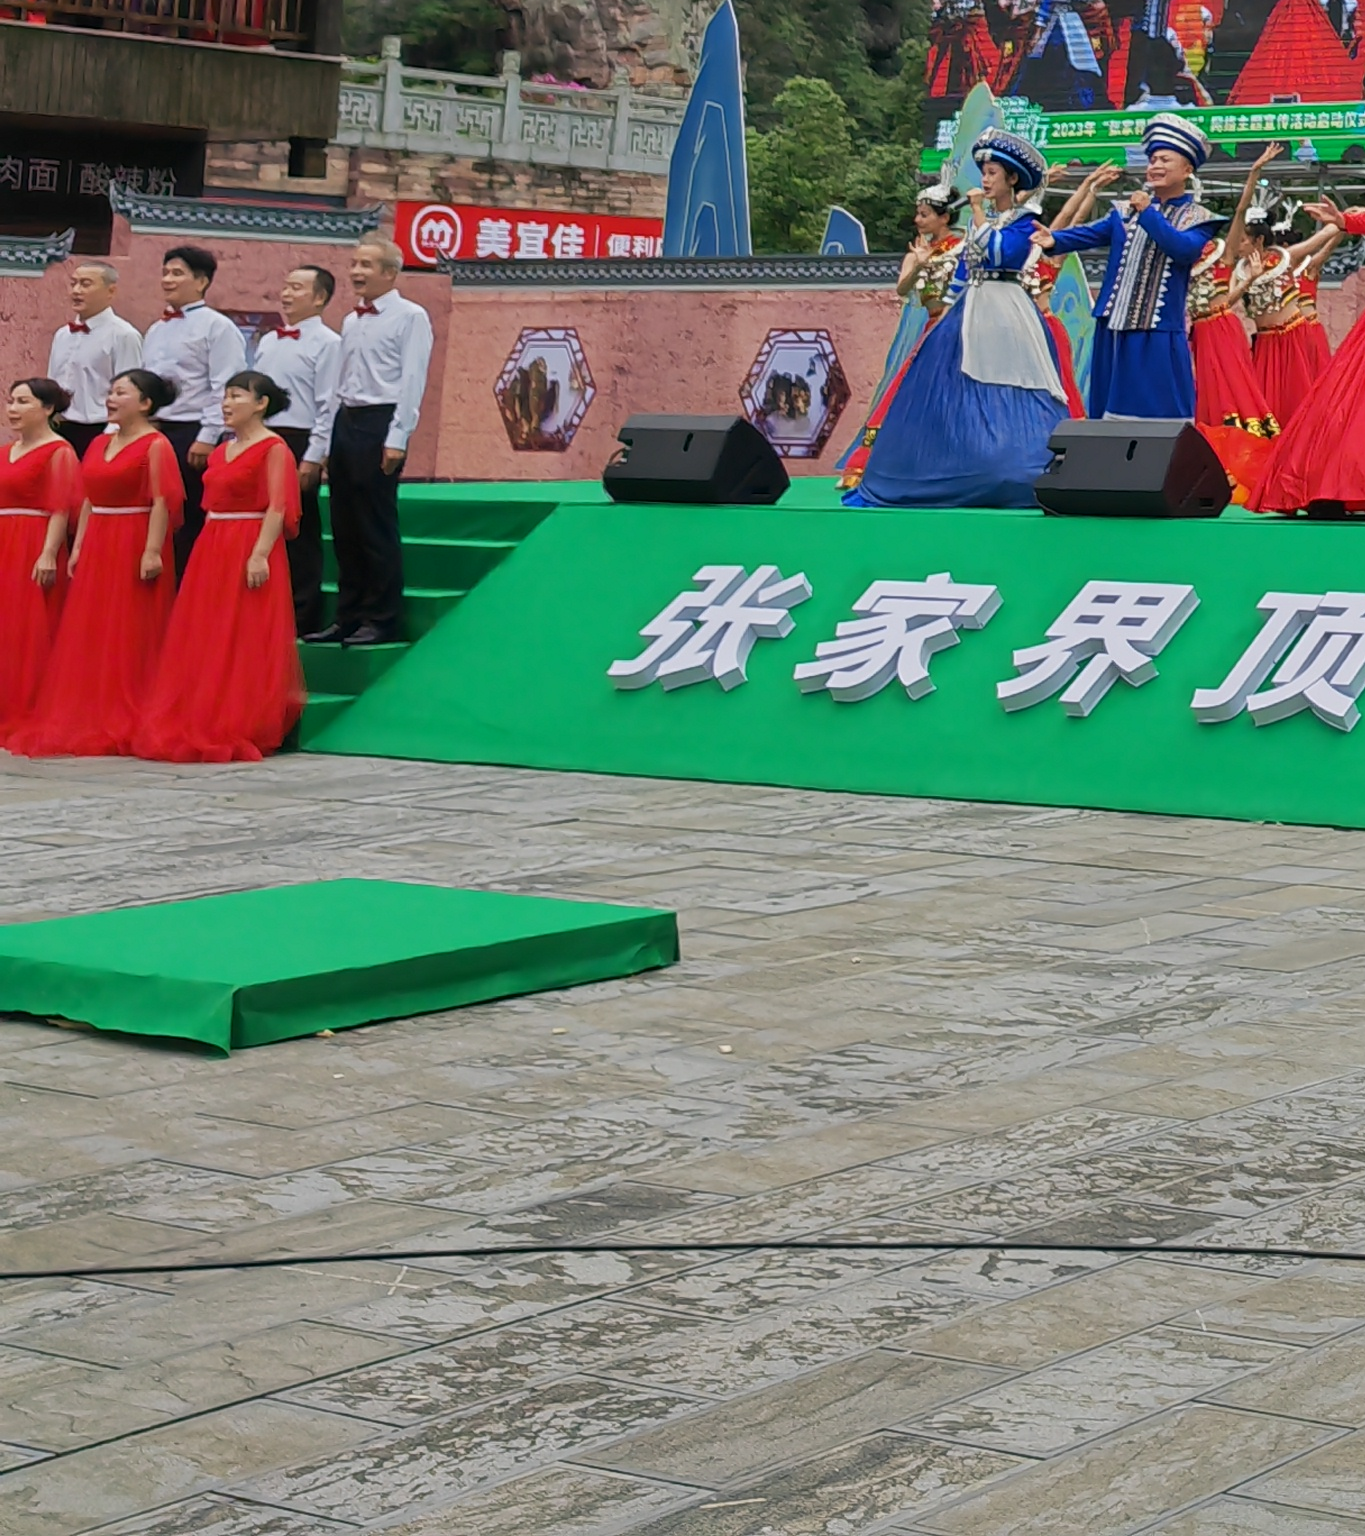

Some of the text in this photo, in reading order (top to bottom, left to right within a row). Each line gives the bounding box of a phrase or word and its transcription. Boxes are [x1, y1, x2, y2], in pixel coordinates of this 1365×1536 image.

[1051, 120, 1097, 138] 2023年
[475, 217, 586, 259] 美宜佳
